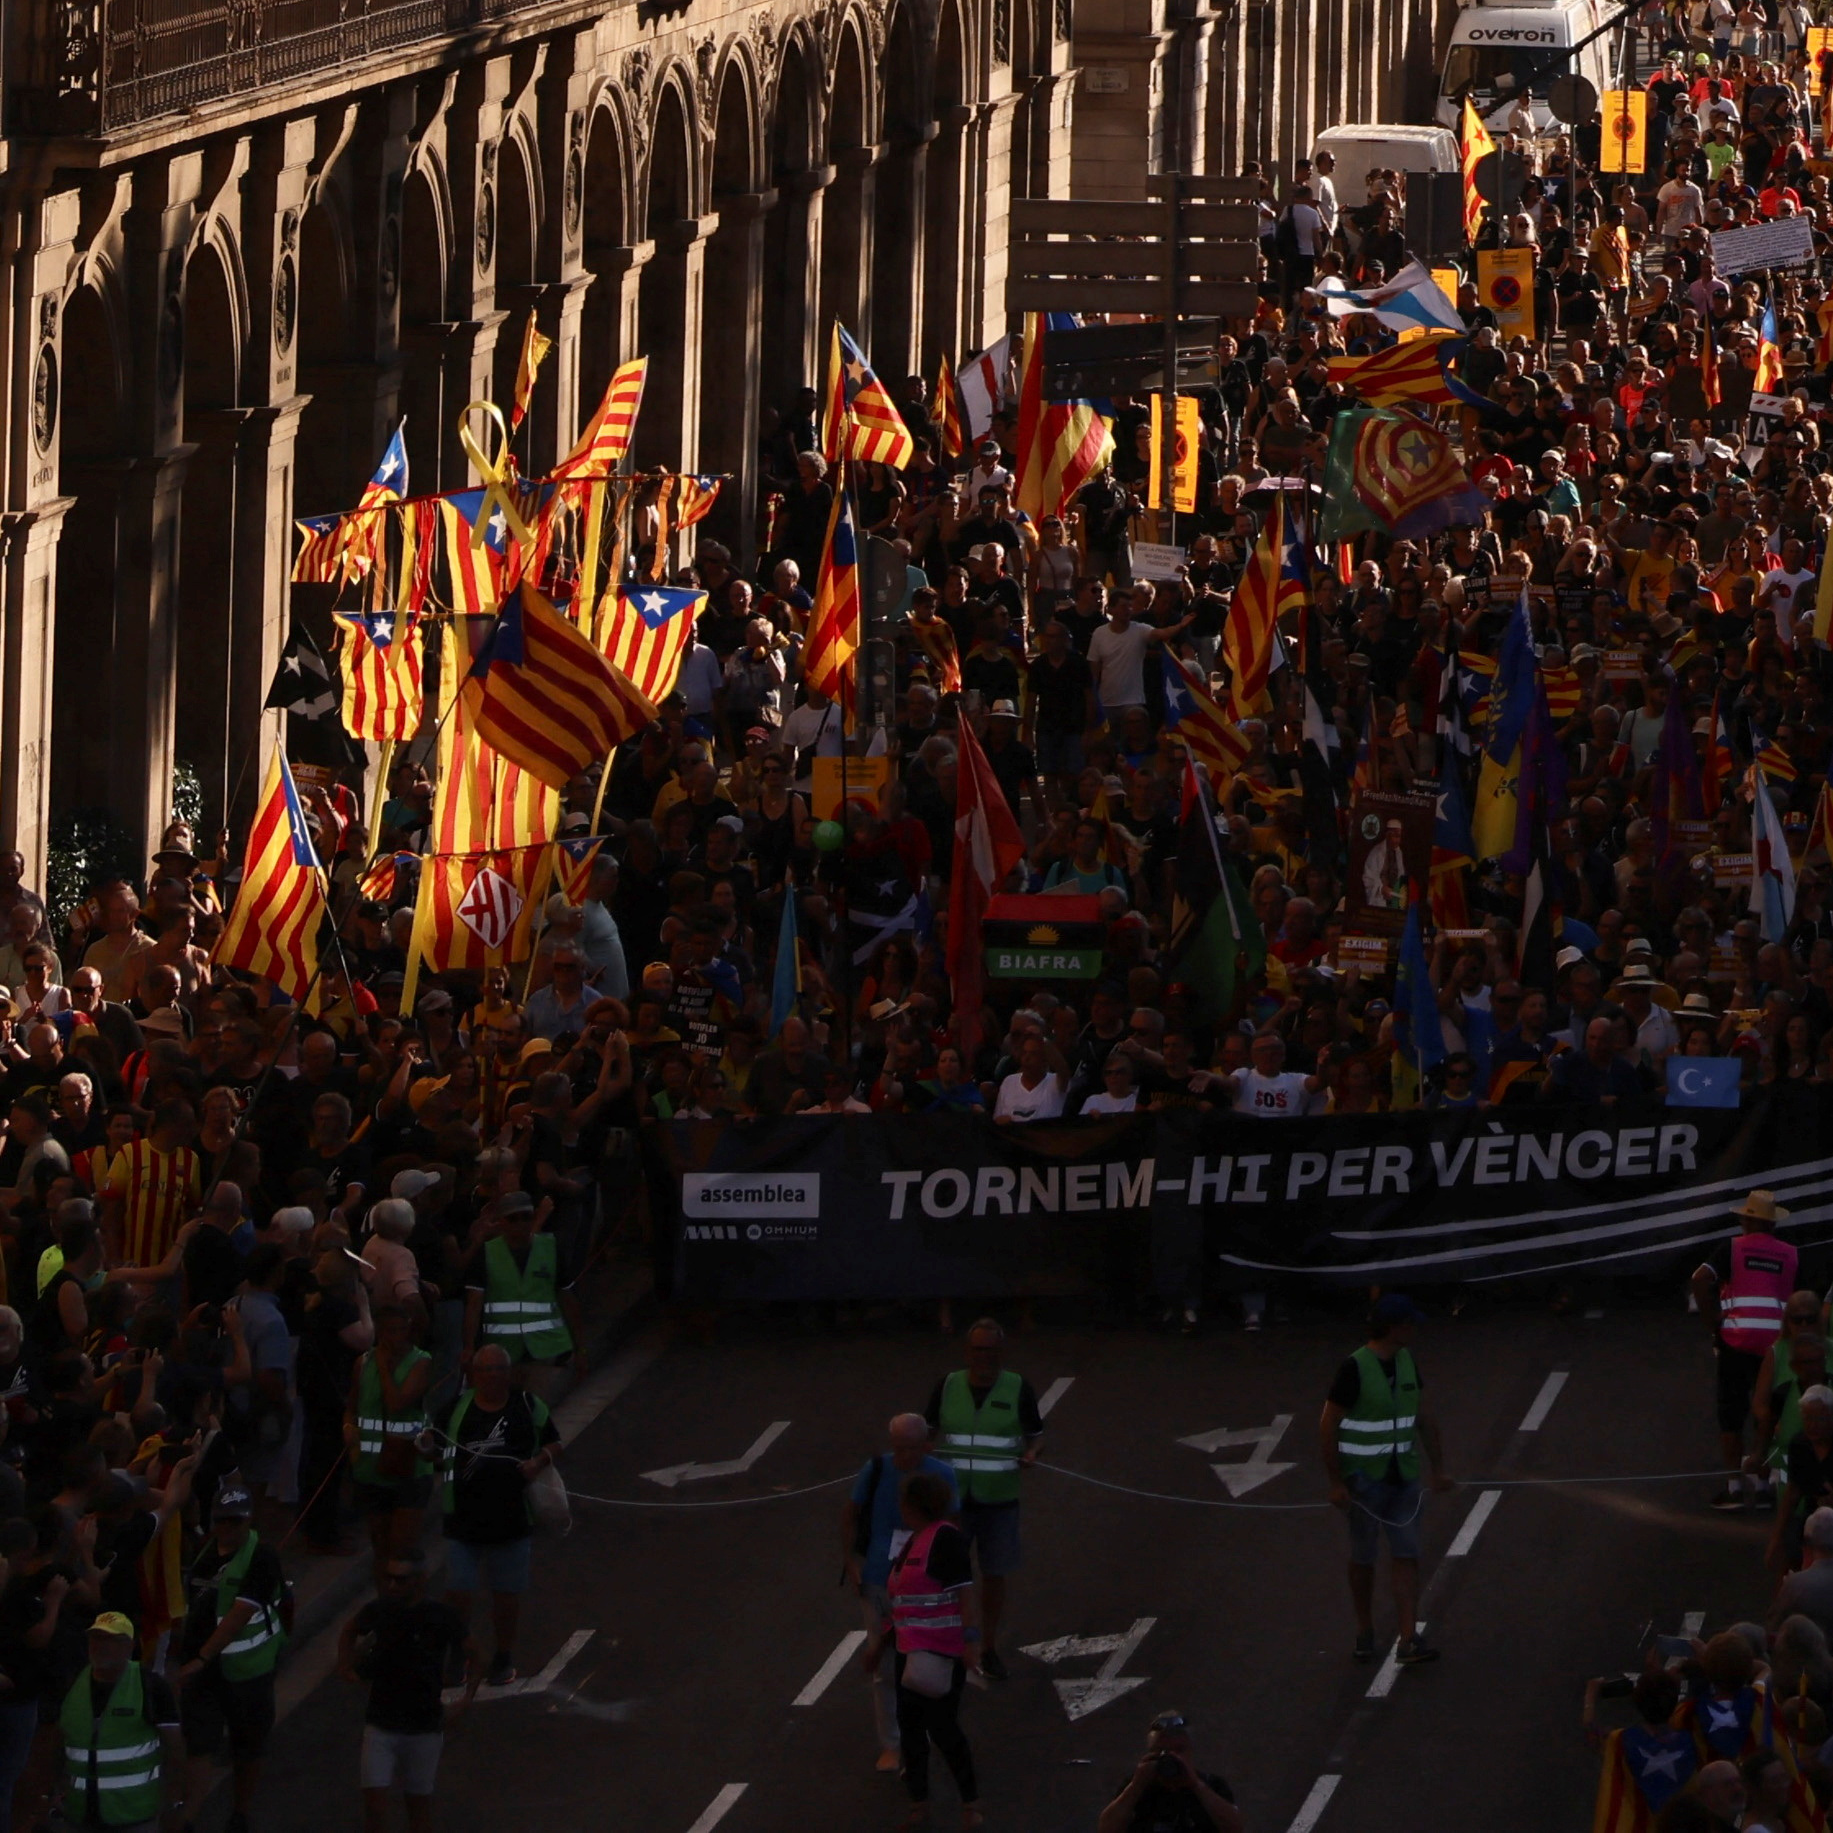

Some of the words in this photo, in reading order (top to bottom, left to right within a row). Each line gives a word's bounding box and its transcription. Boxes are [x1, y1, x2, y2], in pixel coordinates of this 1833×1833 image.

[1468, 29, 1556, 43] overon
[999, 954, 1081, 970] BIAFRA
[1254, 1090, 1288, 1109] SOS
[880, 1153, 1272, 1220] TORNEM-HI
[1284, 1145, 1415, 1201] PER
[1429, 1121, 1700, 1189] VÈNCER
[700, 1184, 806, 1203] assemblea
[764, 1225, 818, 1235] OMNIUM
